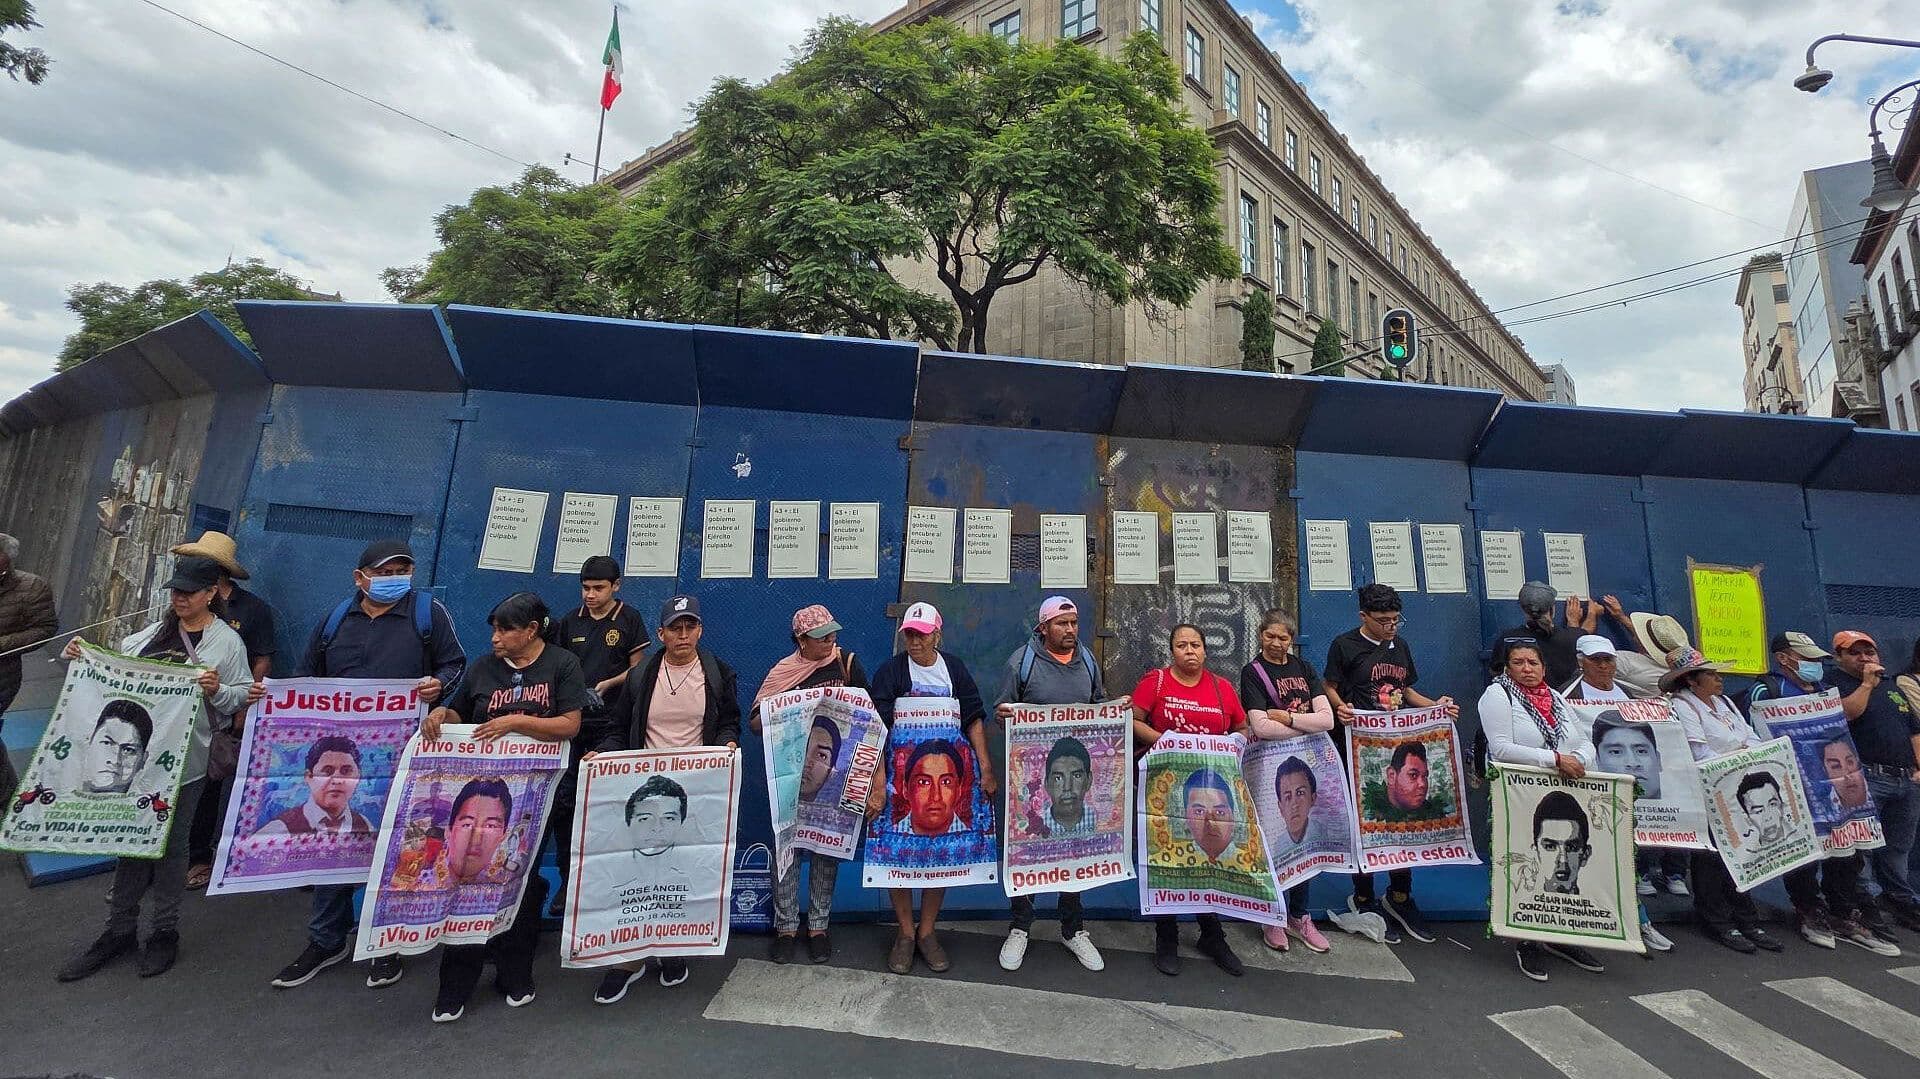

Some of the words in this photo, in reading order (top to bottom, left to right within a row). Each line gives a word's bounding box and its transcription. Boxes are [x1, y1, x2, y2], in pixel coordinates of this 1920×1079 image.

[108, 679, 120, 689] se
[122, 679, 134, 693] lo
[264, 689, 420, 715] ¡Justicia!
[486, 682, 550, 713] AYOTINAPA
[770, 694, 802, 713] ¡Vivo
[805, 690, 820, 700] se
[823, 687, 833, 697] lo
[910, 710, 929, 718] vivo
[1011, 709, 1046, 725] ¡Nos
[1050, 707, 1095, 722] faltan
[1762, 705, 1797, 719] ¡Vivo
[1799, 703, 1812, 713] se
[1812, 701, 1823, 712] lo
[1391, 712, 1426, 728] faltan
[414, 738, 454, 757] ¡Vivo
[457, 741, 476, 754] se
[481, 741, 495, 755] lo
[497, 740, 562, 756] llevaron!
[1178, 739, 1192, 750] se
[1196, 738, 1207, 751] lo
[854, 746, 879, 768] NOS
[1728, 757, 1738, 766] se
[1739, 754, 1749, 763] lo
[592, 761, 628, 778] ¡Vivo
[634, 761, 650, 773] se
[654, 757, 667, 772] lo
[670, 756, 730, 772] llevaron!
[844, 767, 873, 803] FALTAN
[1507, 774, 1535, 786] ¡Vivo
[44, 821, 77, 833] VIDA
[77, 822, 90, 833] lo
[1637, 830, 1647, 841] lo
[1295, 853, 1345, 875] queremos!
[1366, 849, 1418, 866] Dónde
[1421, 844, 1465, 861] están
[887, 869, 911, 881] ¡Vivo
[913, 868, 922, 879] lo
[924, 868, 970, 880] queremos!
[1012, 867, 1071, 888] Dónde
[1075, 859, 1122, 881] están
[621, 894, 687, 906] NAVARRETE
[1154, 890, 1185, 905] ¡Vivo
[1189, 890, 1200, 902] lo
[1203, 893, 1271, 914] queremos!
[1512, 911, 1533, 923] ¡Con
[1534, 913, 1557, 925] VIDA
[1558, 915, 1567, 926] lo
[1567, 918, 1617, 931] queremos!
[378, 926, 419, 947] ¡Vivo
[424, 926, 440, 941] lo
[578, 934, 606, 951] ¡Con
[610, 927, 640, 944] VIDA
[642, 923, 653, 937] lo
[655, 921, 715, 939] queremos!
